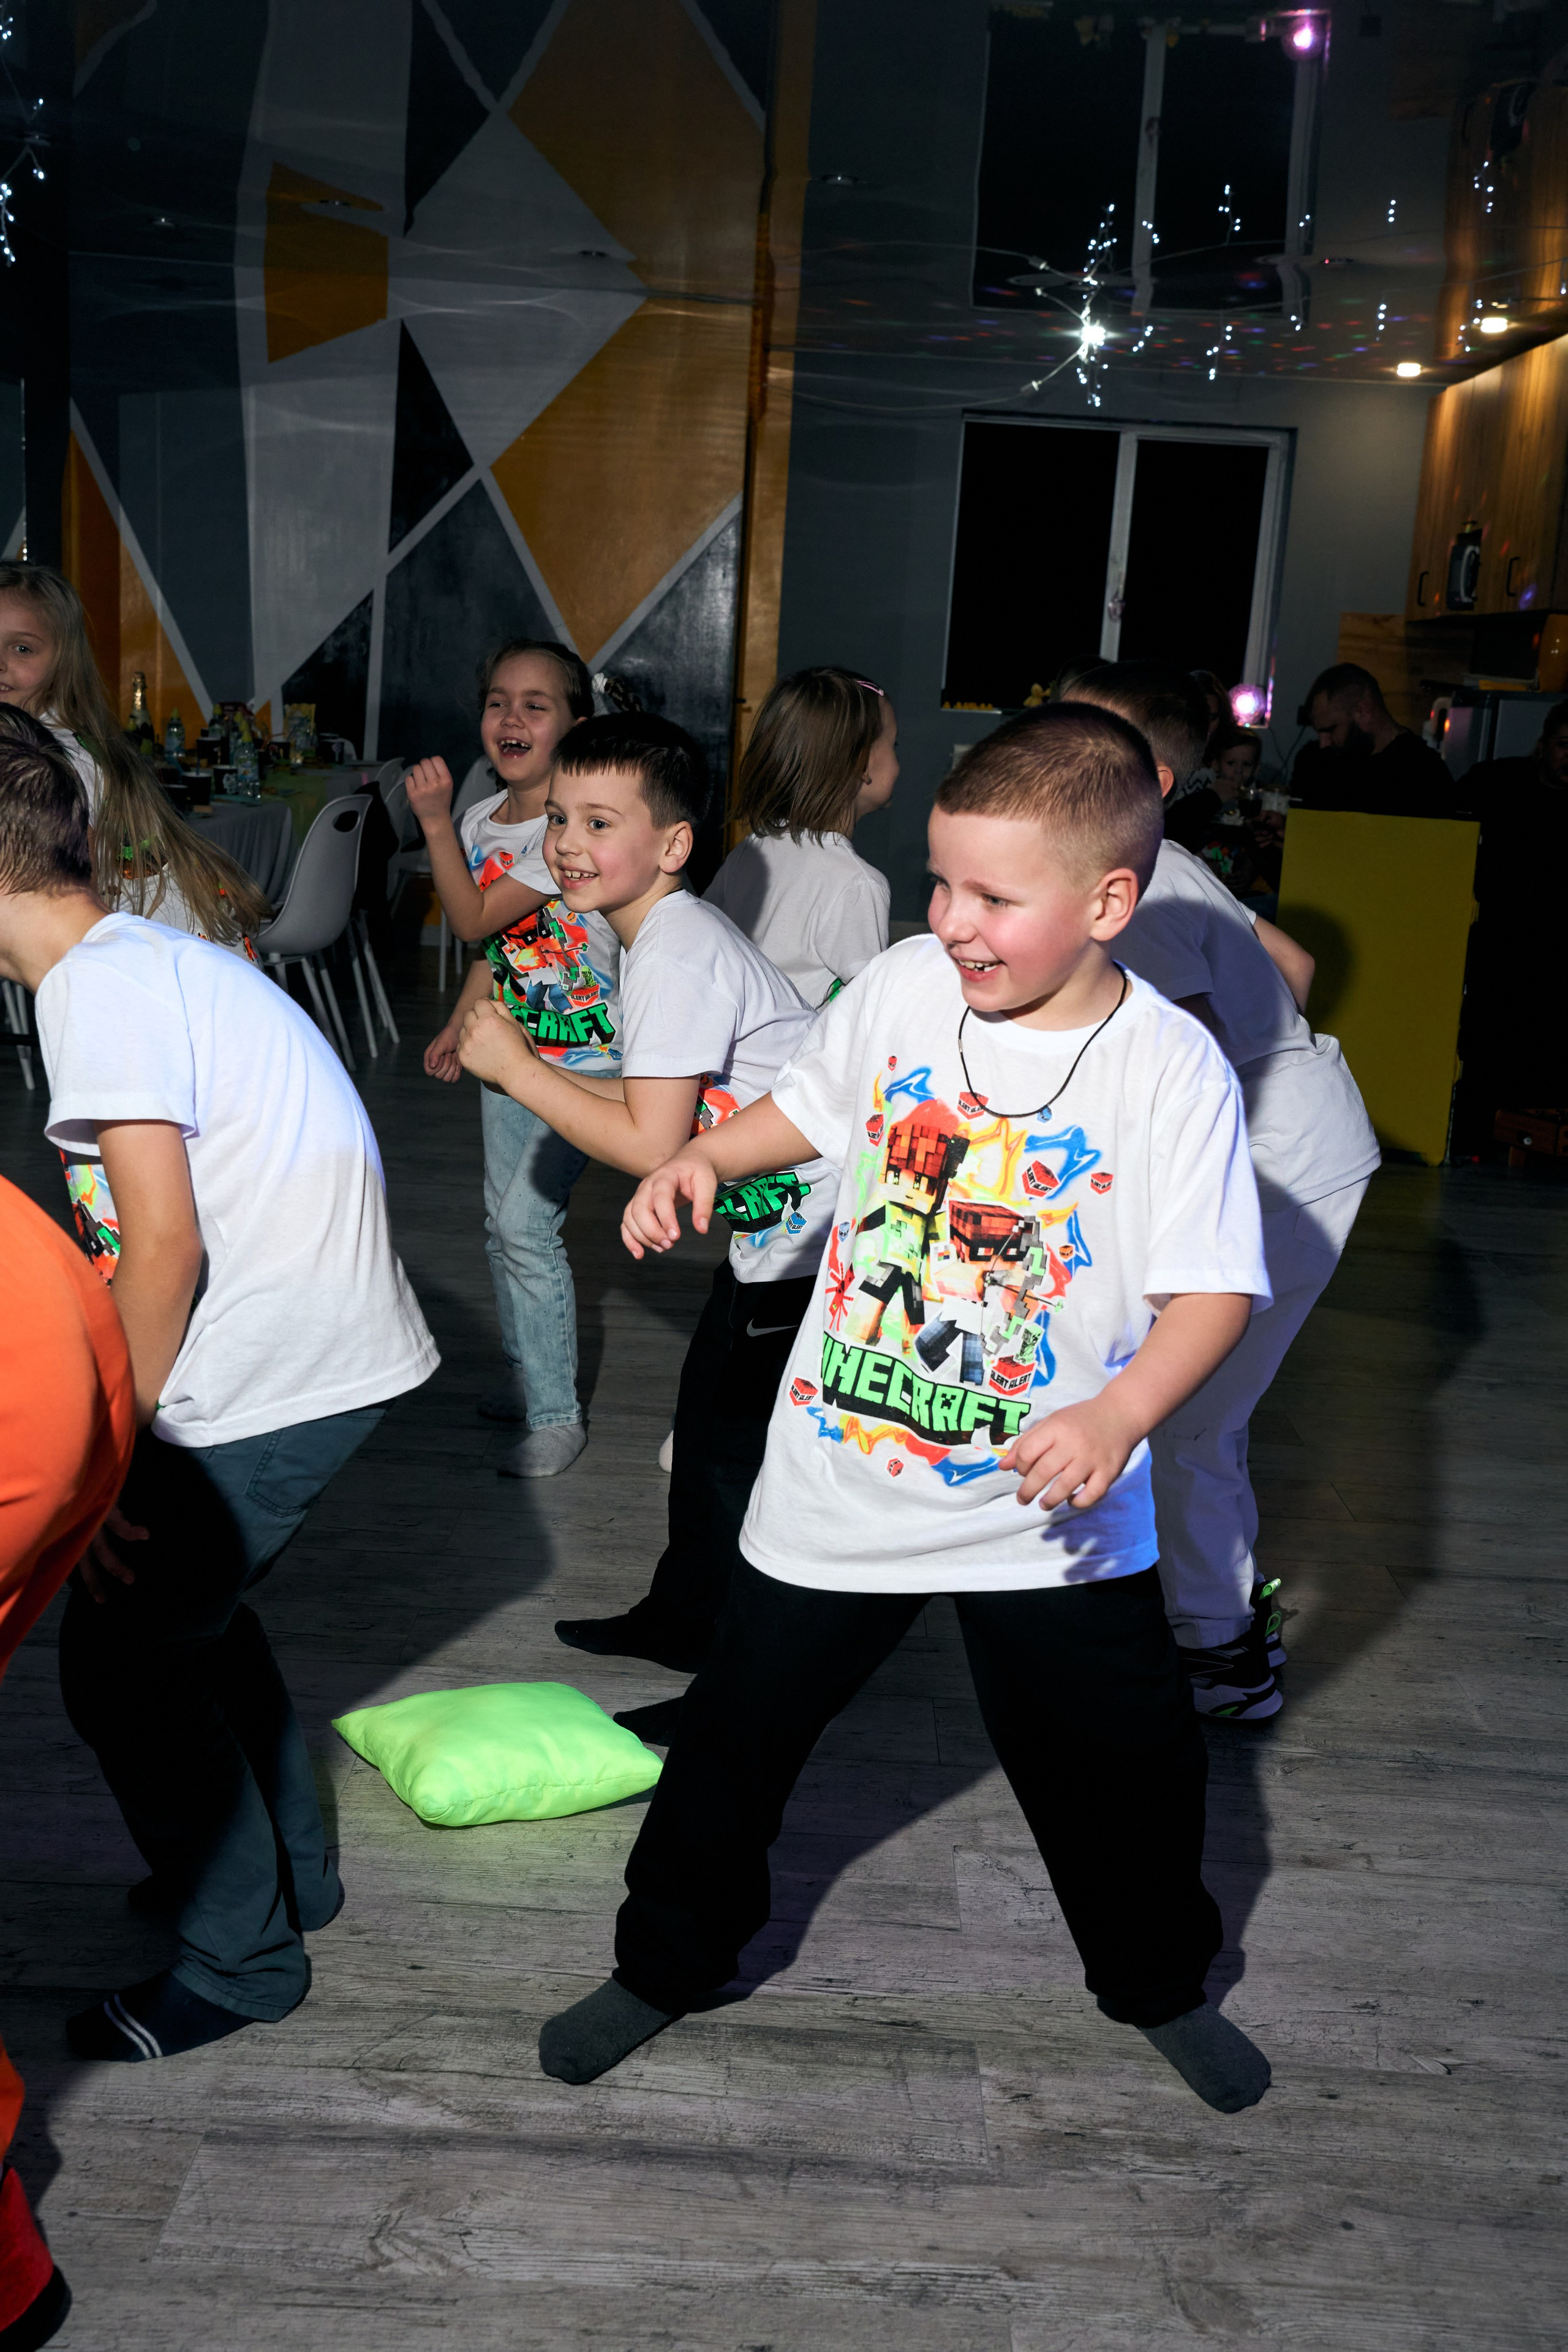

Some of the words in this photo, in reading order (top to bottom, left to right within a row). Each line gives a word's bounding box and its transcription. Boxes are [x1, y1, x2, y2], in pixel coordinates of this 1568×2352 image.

[585, 990, 598, 1001] ALERT
[821, 1331, 1031, 1436] INECRAFT
[990, 1370, 1009, 1389] ALERT
[1008, 1373, 1031, 1389] ALERT
